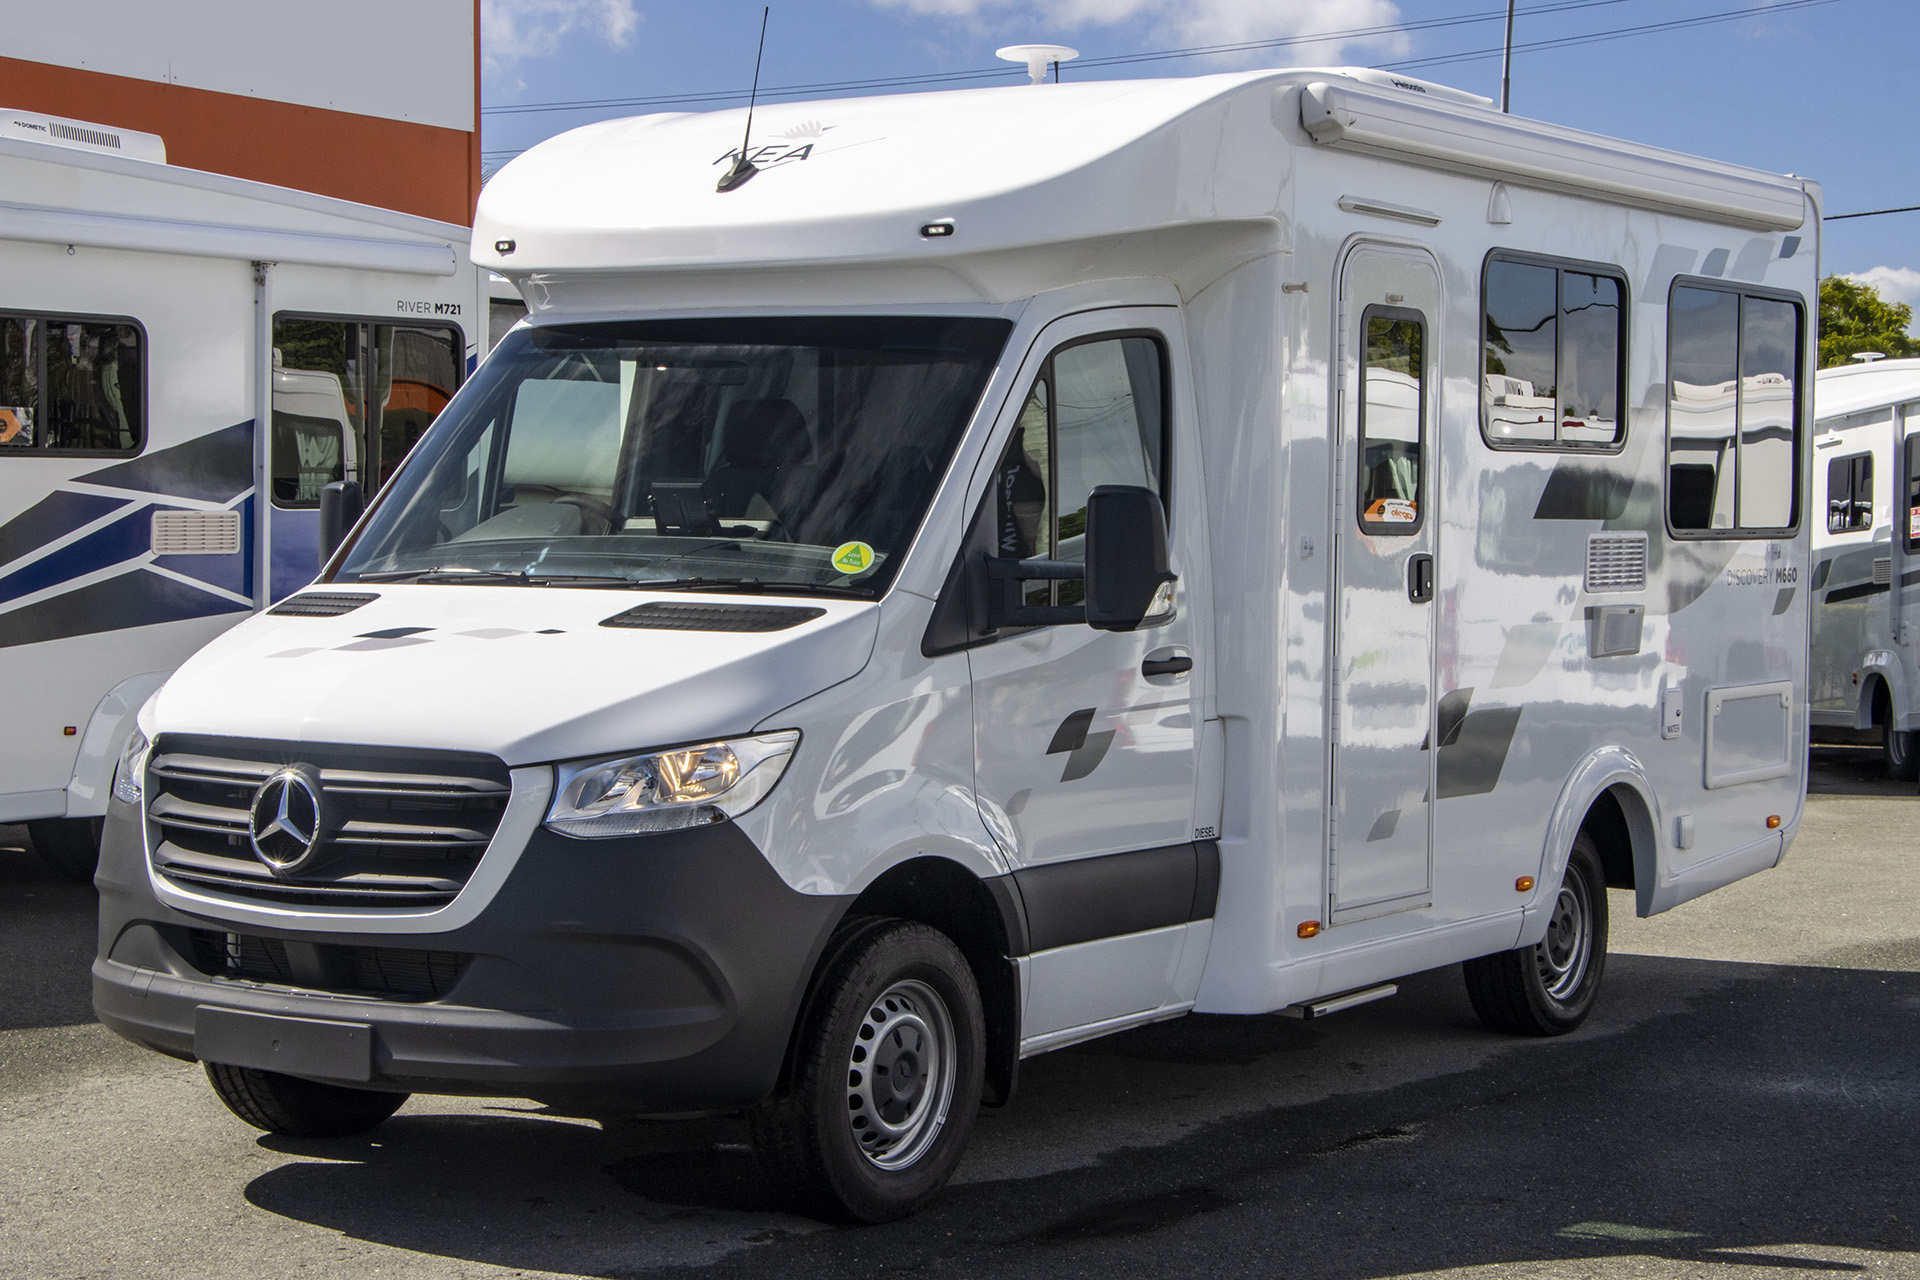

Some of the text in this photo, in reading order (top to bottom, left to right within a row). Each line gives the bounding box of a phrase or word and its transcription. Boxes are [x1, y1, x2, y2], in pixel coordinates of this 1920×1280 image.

[21, 121, 47, 132] DOMETIC
[396, 300, 461, 315] RIVER M721
[1726, 566, 1798, 587] DISCOVERY M660
[1194, 826, 1216, 839] DIESEL
